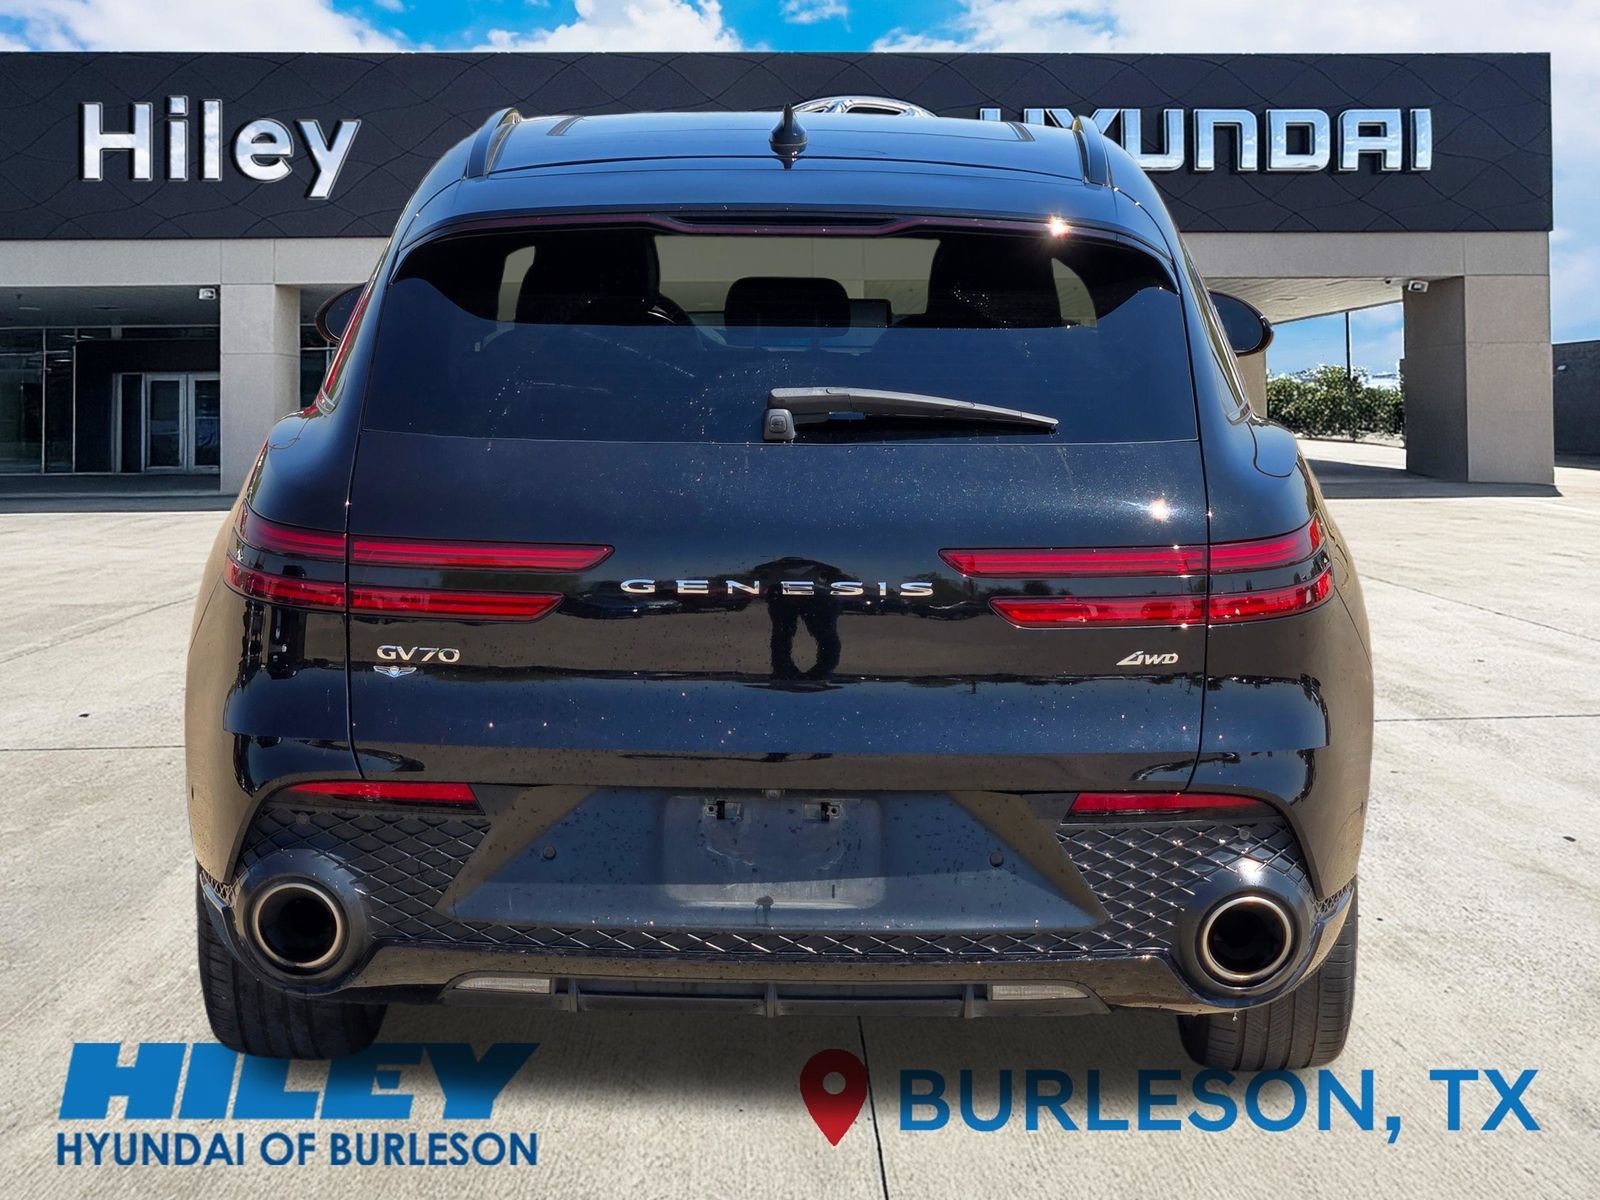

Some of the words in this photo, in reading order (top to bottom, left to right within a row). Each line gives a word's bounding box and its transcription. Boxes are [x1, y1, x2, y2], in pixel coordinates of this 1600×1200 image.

[80, 95, 361, 200] Hiley
[980, 107, 1433, 172] UNDAI
[620, 578, 935, 597] GENESIS
[376, 644, 461, 663] GV70
